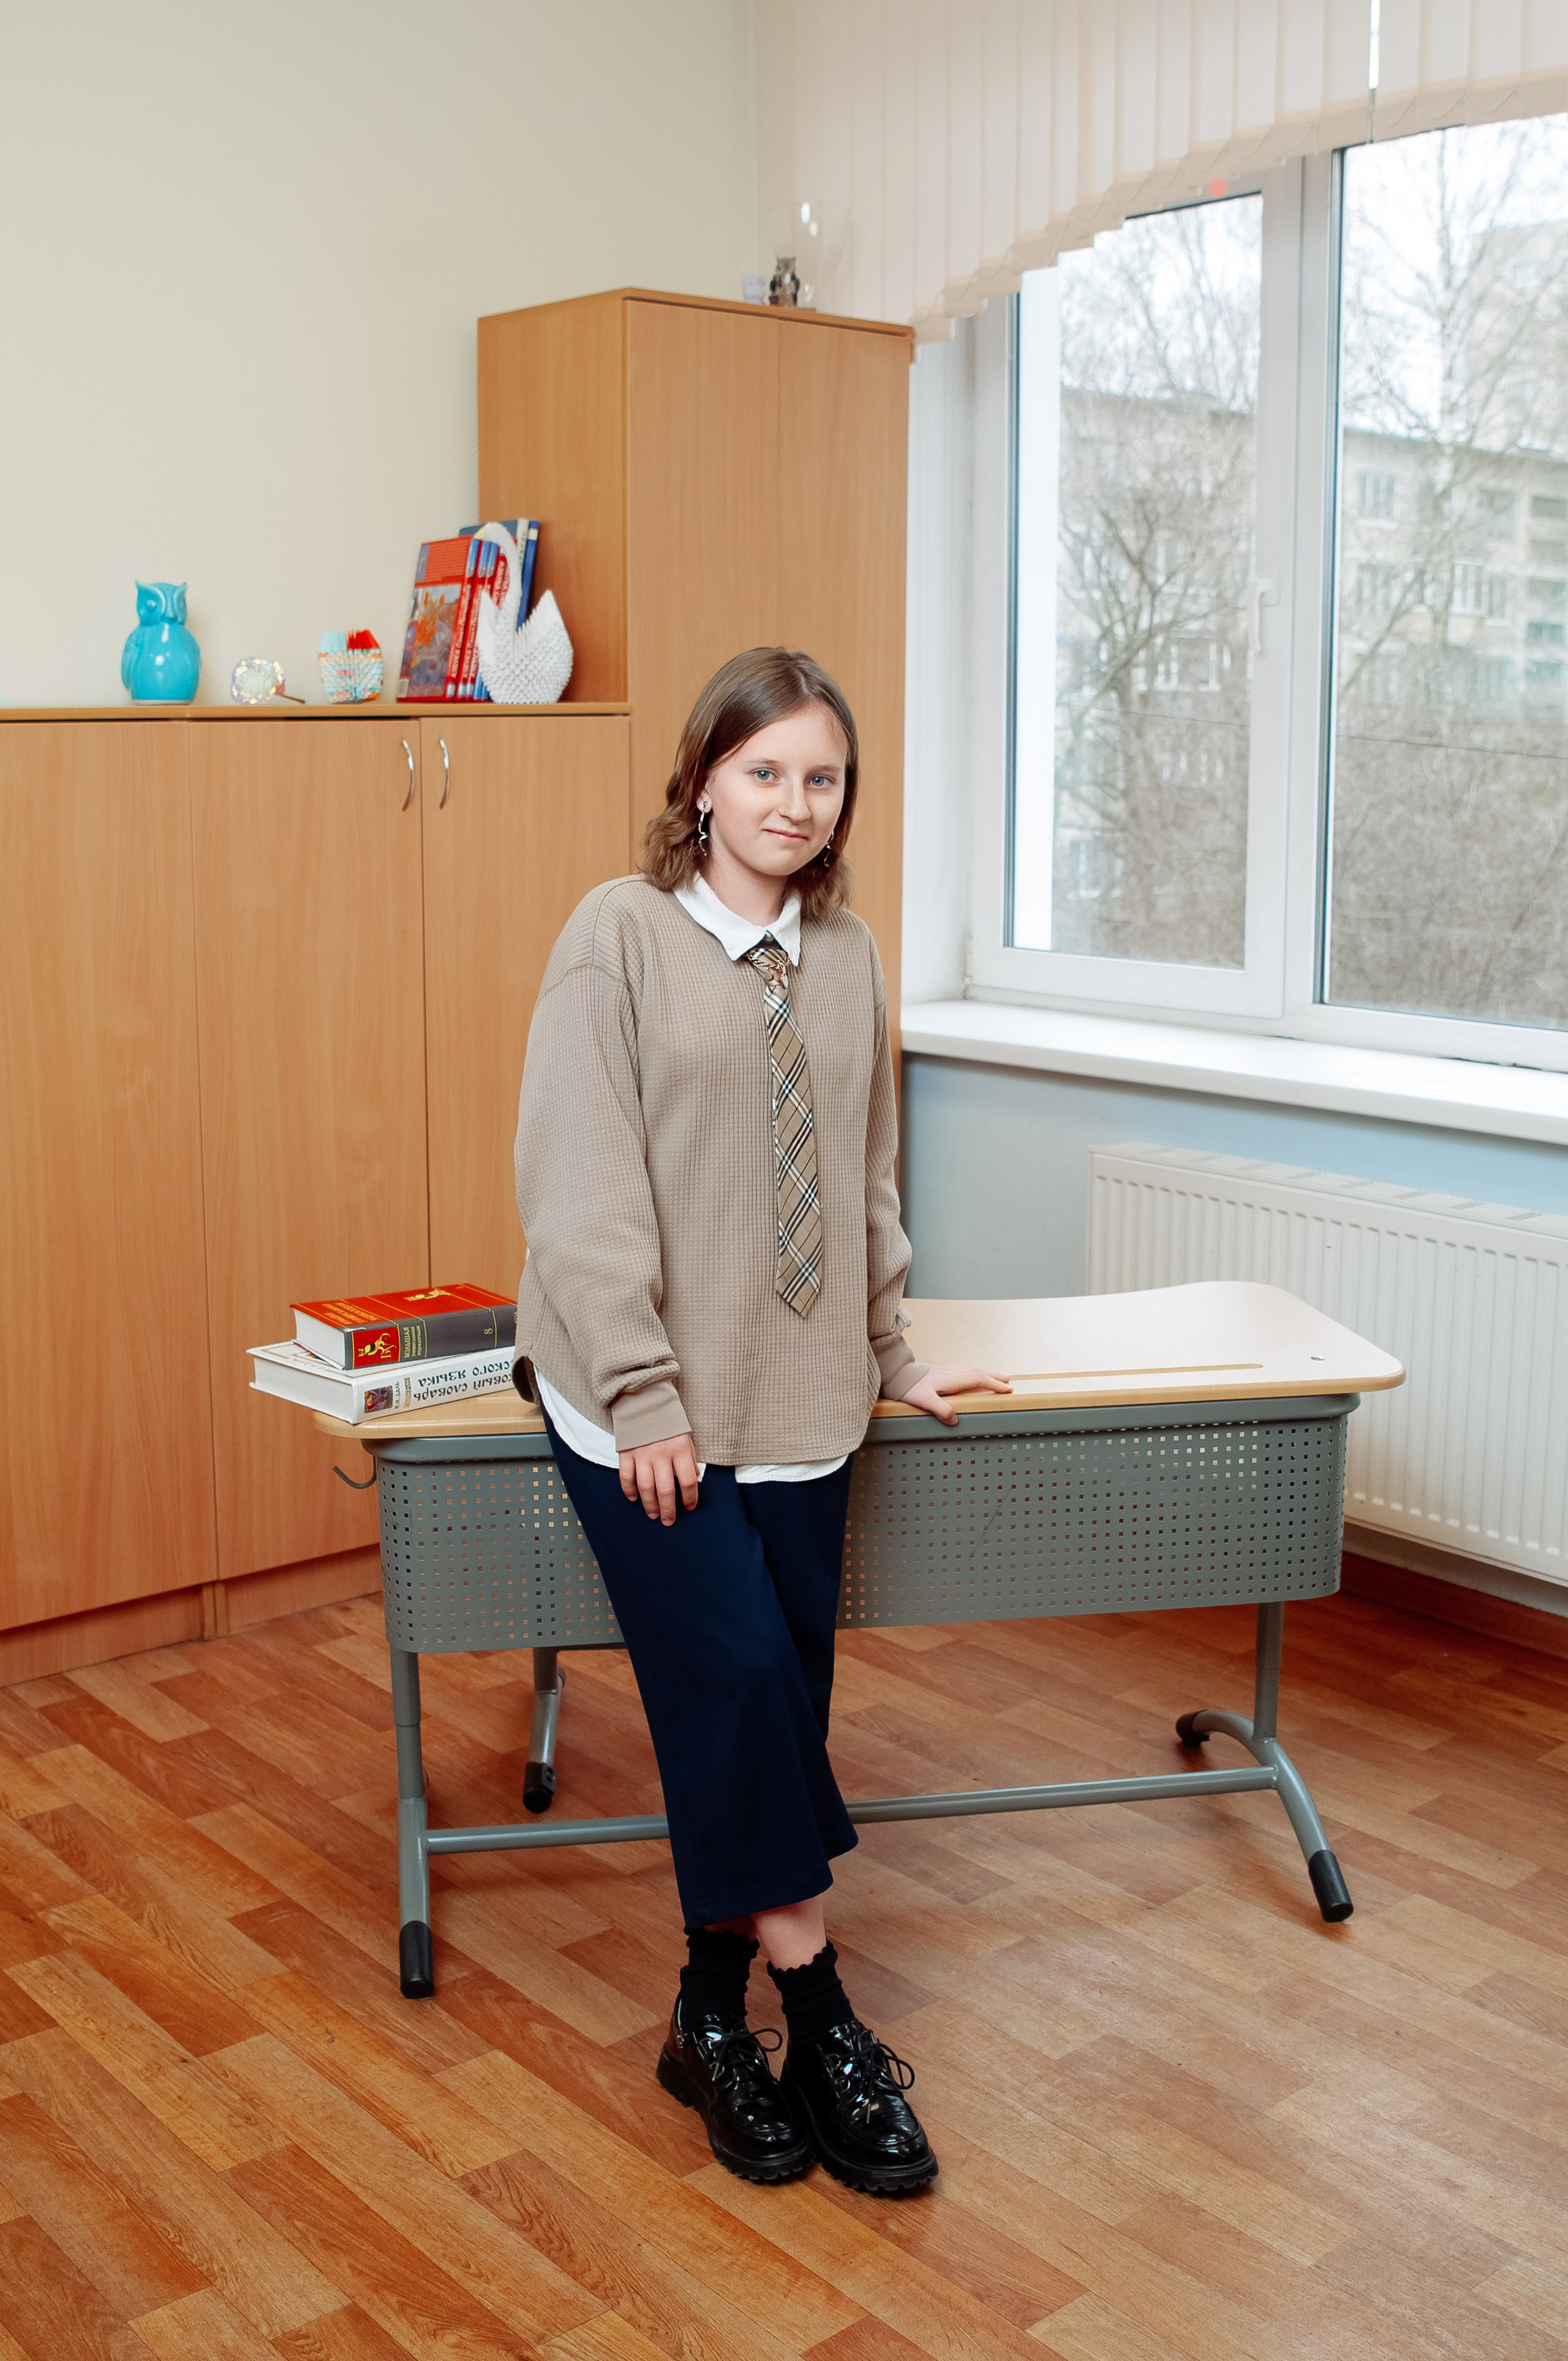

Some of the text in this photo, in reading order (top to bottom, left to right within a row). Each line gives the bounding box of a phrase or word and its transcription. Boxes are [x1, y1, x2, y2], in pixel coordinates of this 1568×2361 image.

[418, 1360, 513, 1387] ского языка
[413, 1383, 468, 1401] словарь
